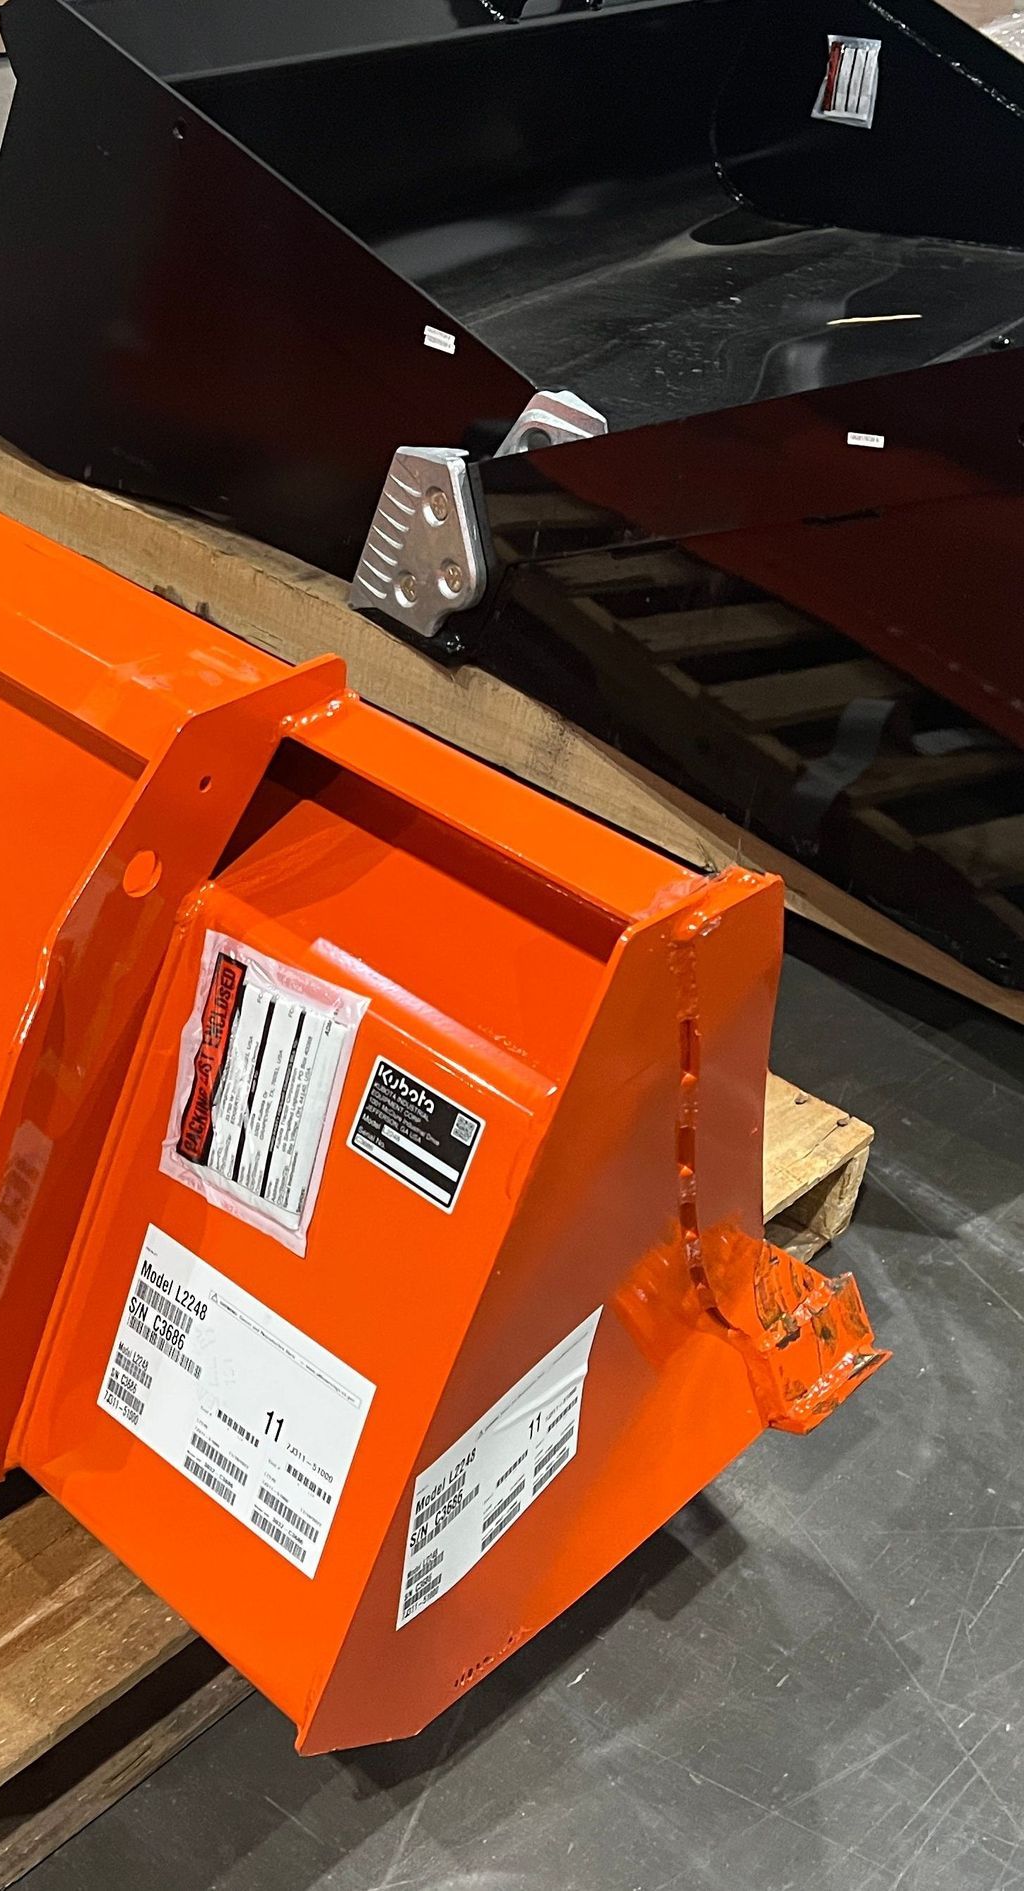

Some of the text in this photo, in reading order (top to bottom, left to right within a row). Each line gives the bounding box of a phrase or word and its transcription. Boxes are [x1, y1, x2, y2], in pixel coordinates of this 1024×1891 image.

[203, 967, 237, 1049] ENCLOSED
[370, 1088, 404, 1112] EQUIPMENT
[373, 1082, 429, 1122] KUBOTA INDUSTRIAL
[378, 1064, 434, 1113] Kubota
[358, 1125, 375, 1141] Serial
[362, 1113, 381, 1129] Model
[399, 1125, 409, 1135] GA
[409, 1131, 421, 1143] USA
[140, 1260, 207, 1320] Model L2248
[128, 1296, 185, 1350] S/N C3686
[132, 1351, 149, 1372] L2248
[264, 1411, 284, 1442] 11
[528, 1411, 542, 1440] 11
[415, 1477, 446, 1515] Model
[449, 1447, 477, 1484] L2248
[409, 1522, 428, 1548] S/N
[434, 1488, 464, 1527] C3686
